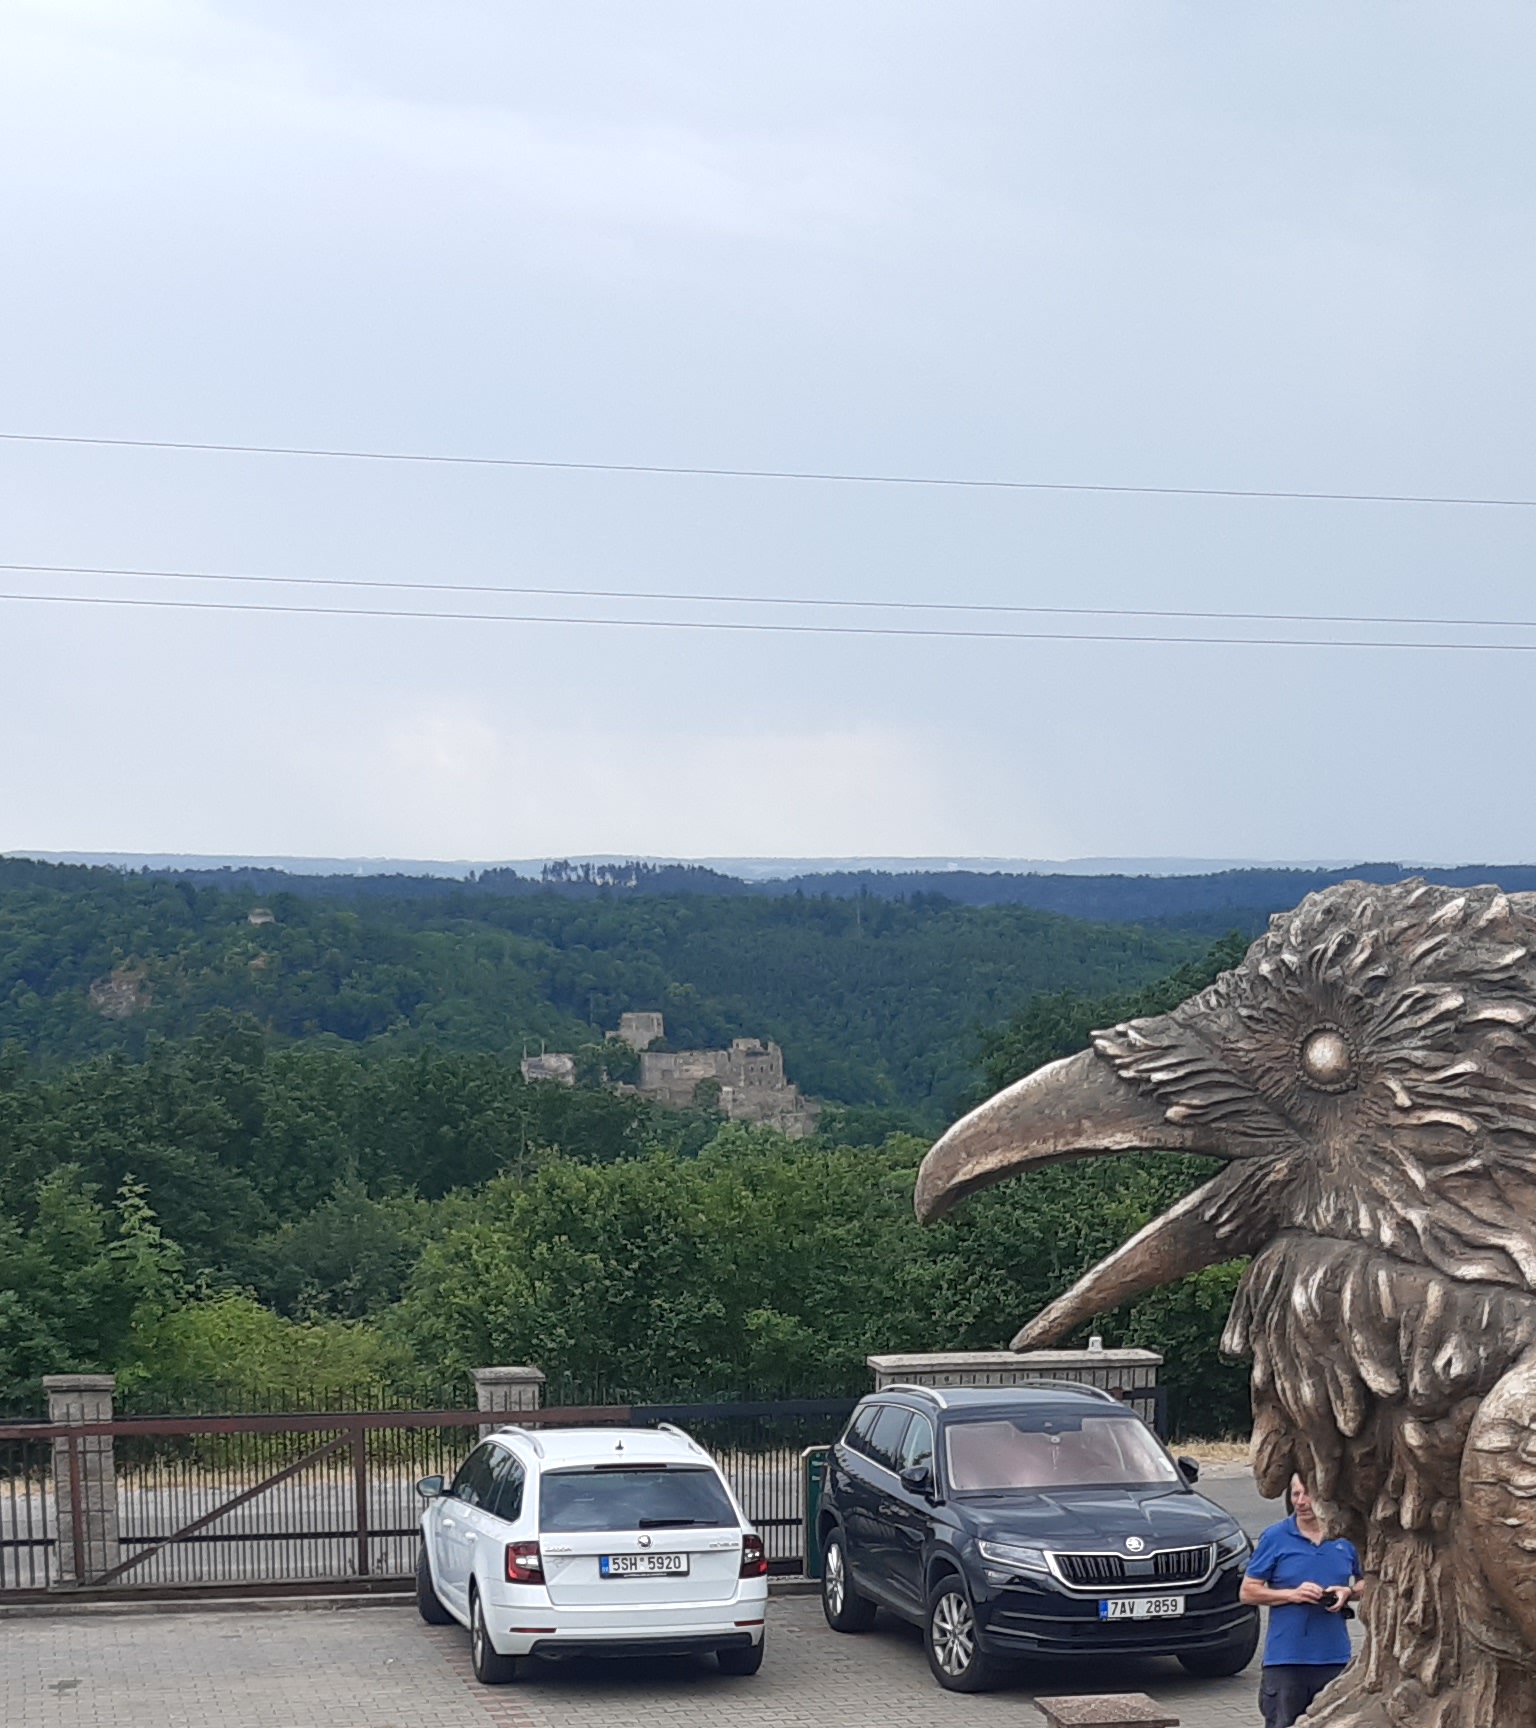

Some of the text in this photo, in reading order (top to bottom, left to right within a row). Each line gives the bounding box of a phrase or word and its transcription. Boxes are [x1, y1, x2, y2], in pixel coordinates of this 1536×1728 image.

[612, 1555, 682, 1571] 5SH 5920
[1111, 1599, 1178, 1615] 7AV 2859
